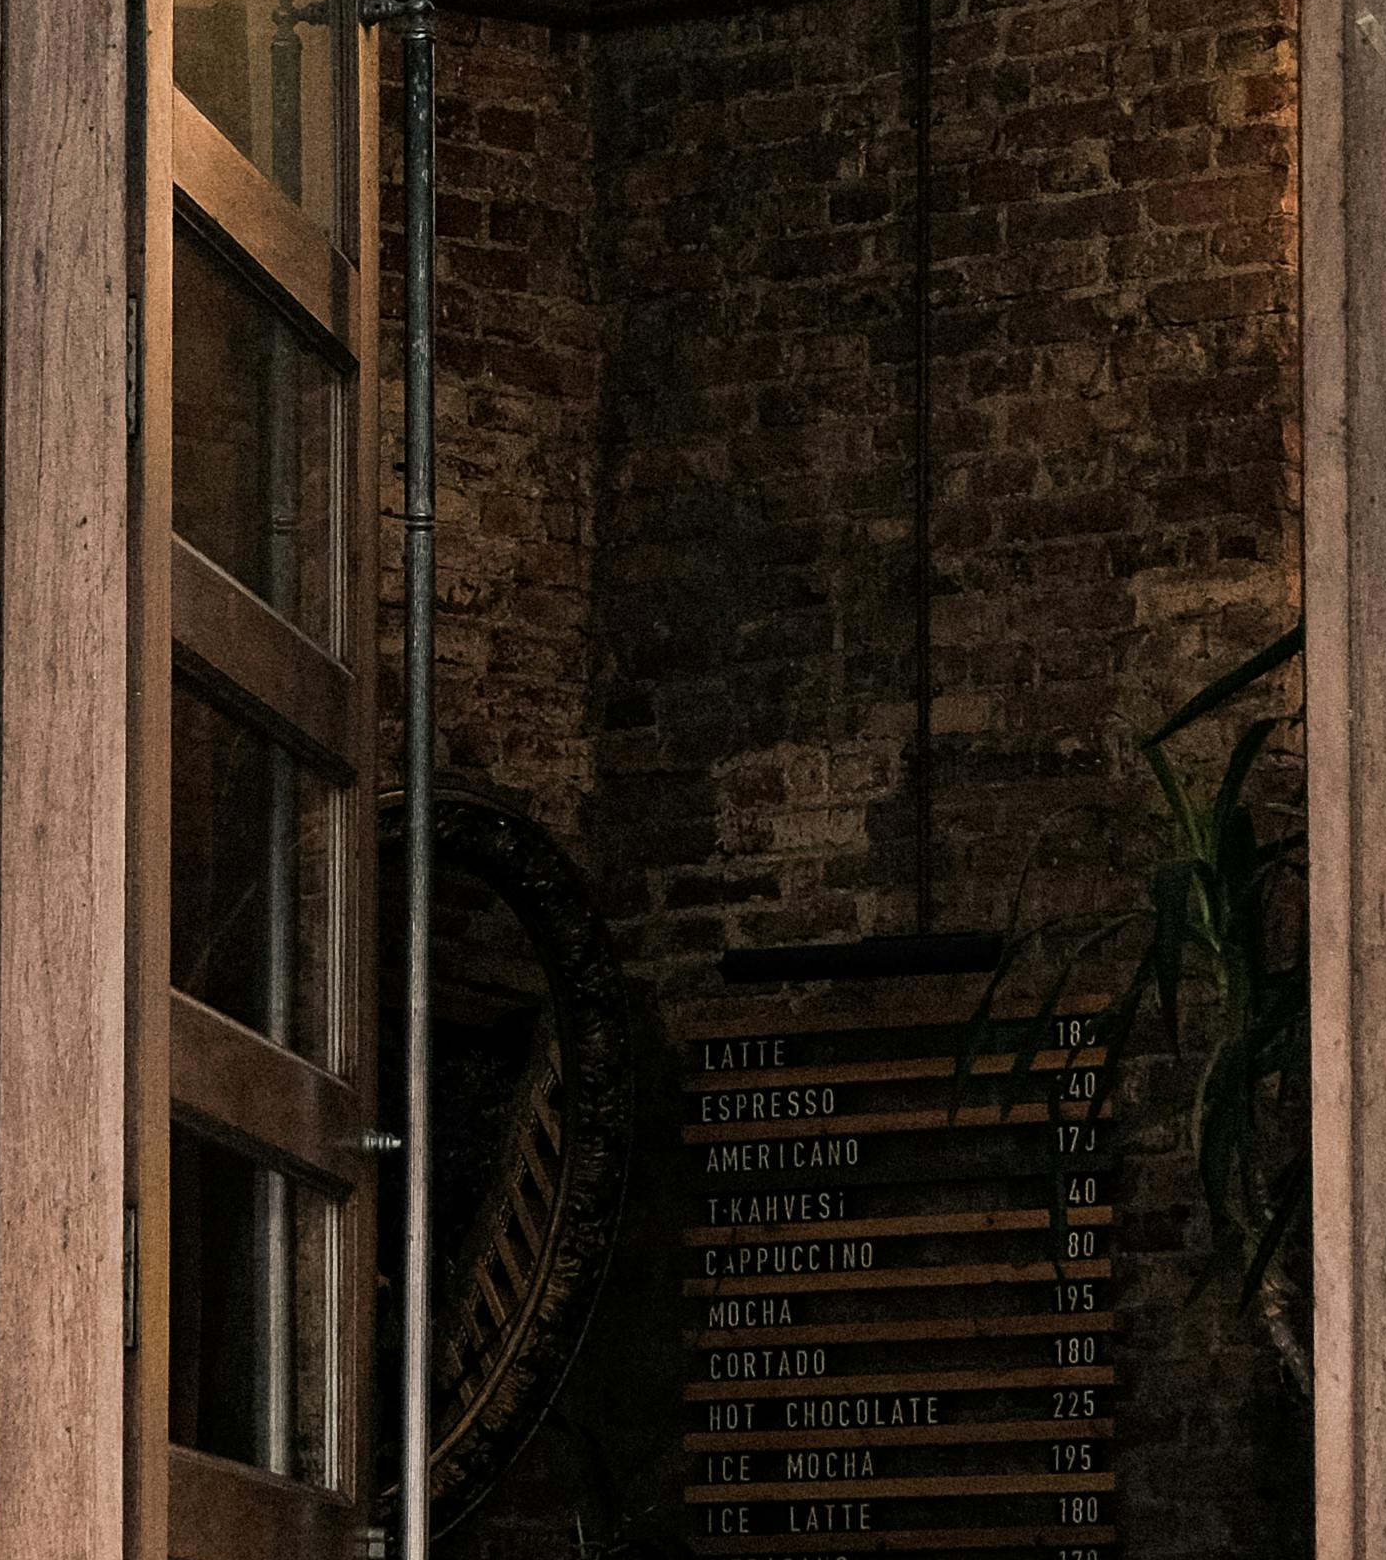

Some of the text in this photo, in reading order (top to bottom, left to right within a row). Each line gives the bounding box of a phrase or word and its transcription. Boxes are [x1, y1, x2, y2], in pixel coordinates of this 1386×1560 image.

[704, 1039, 787, 1071] LATTE
[701, 1071, 1097, 1123] ESPRESSO 40
[706, 1137, 860, 1173] AMERICANO
[704, 1241, 875, 1276] CAPPUCCINO
[708, 1284, 1095, 1329] MOCHA 195
[709, 1337, 1096, 1380] CORTADO 180
[708, 1389, 1096, 1432] HOT CHOCOLATE 225
[707, 1443, 1093, 1484] ICE MOCHA 195
[707, 1496, 1099, 1534] ICE LATTE 180
